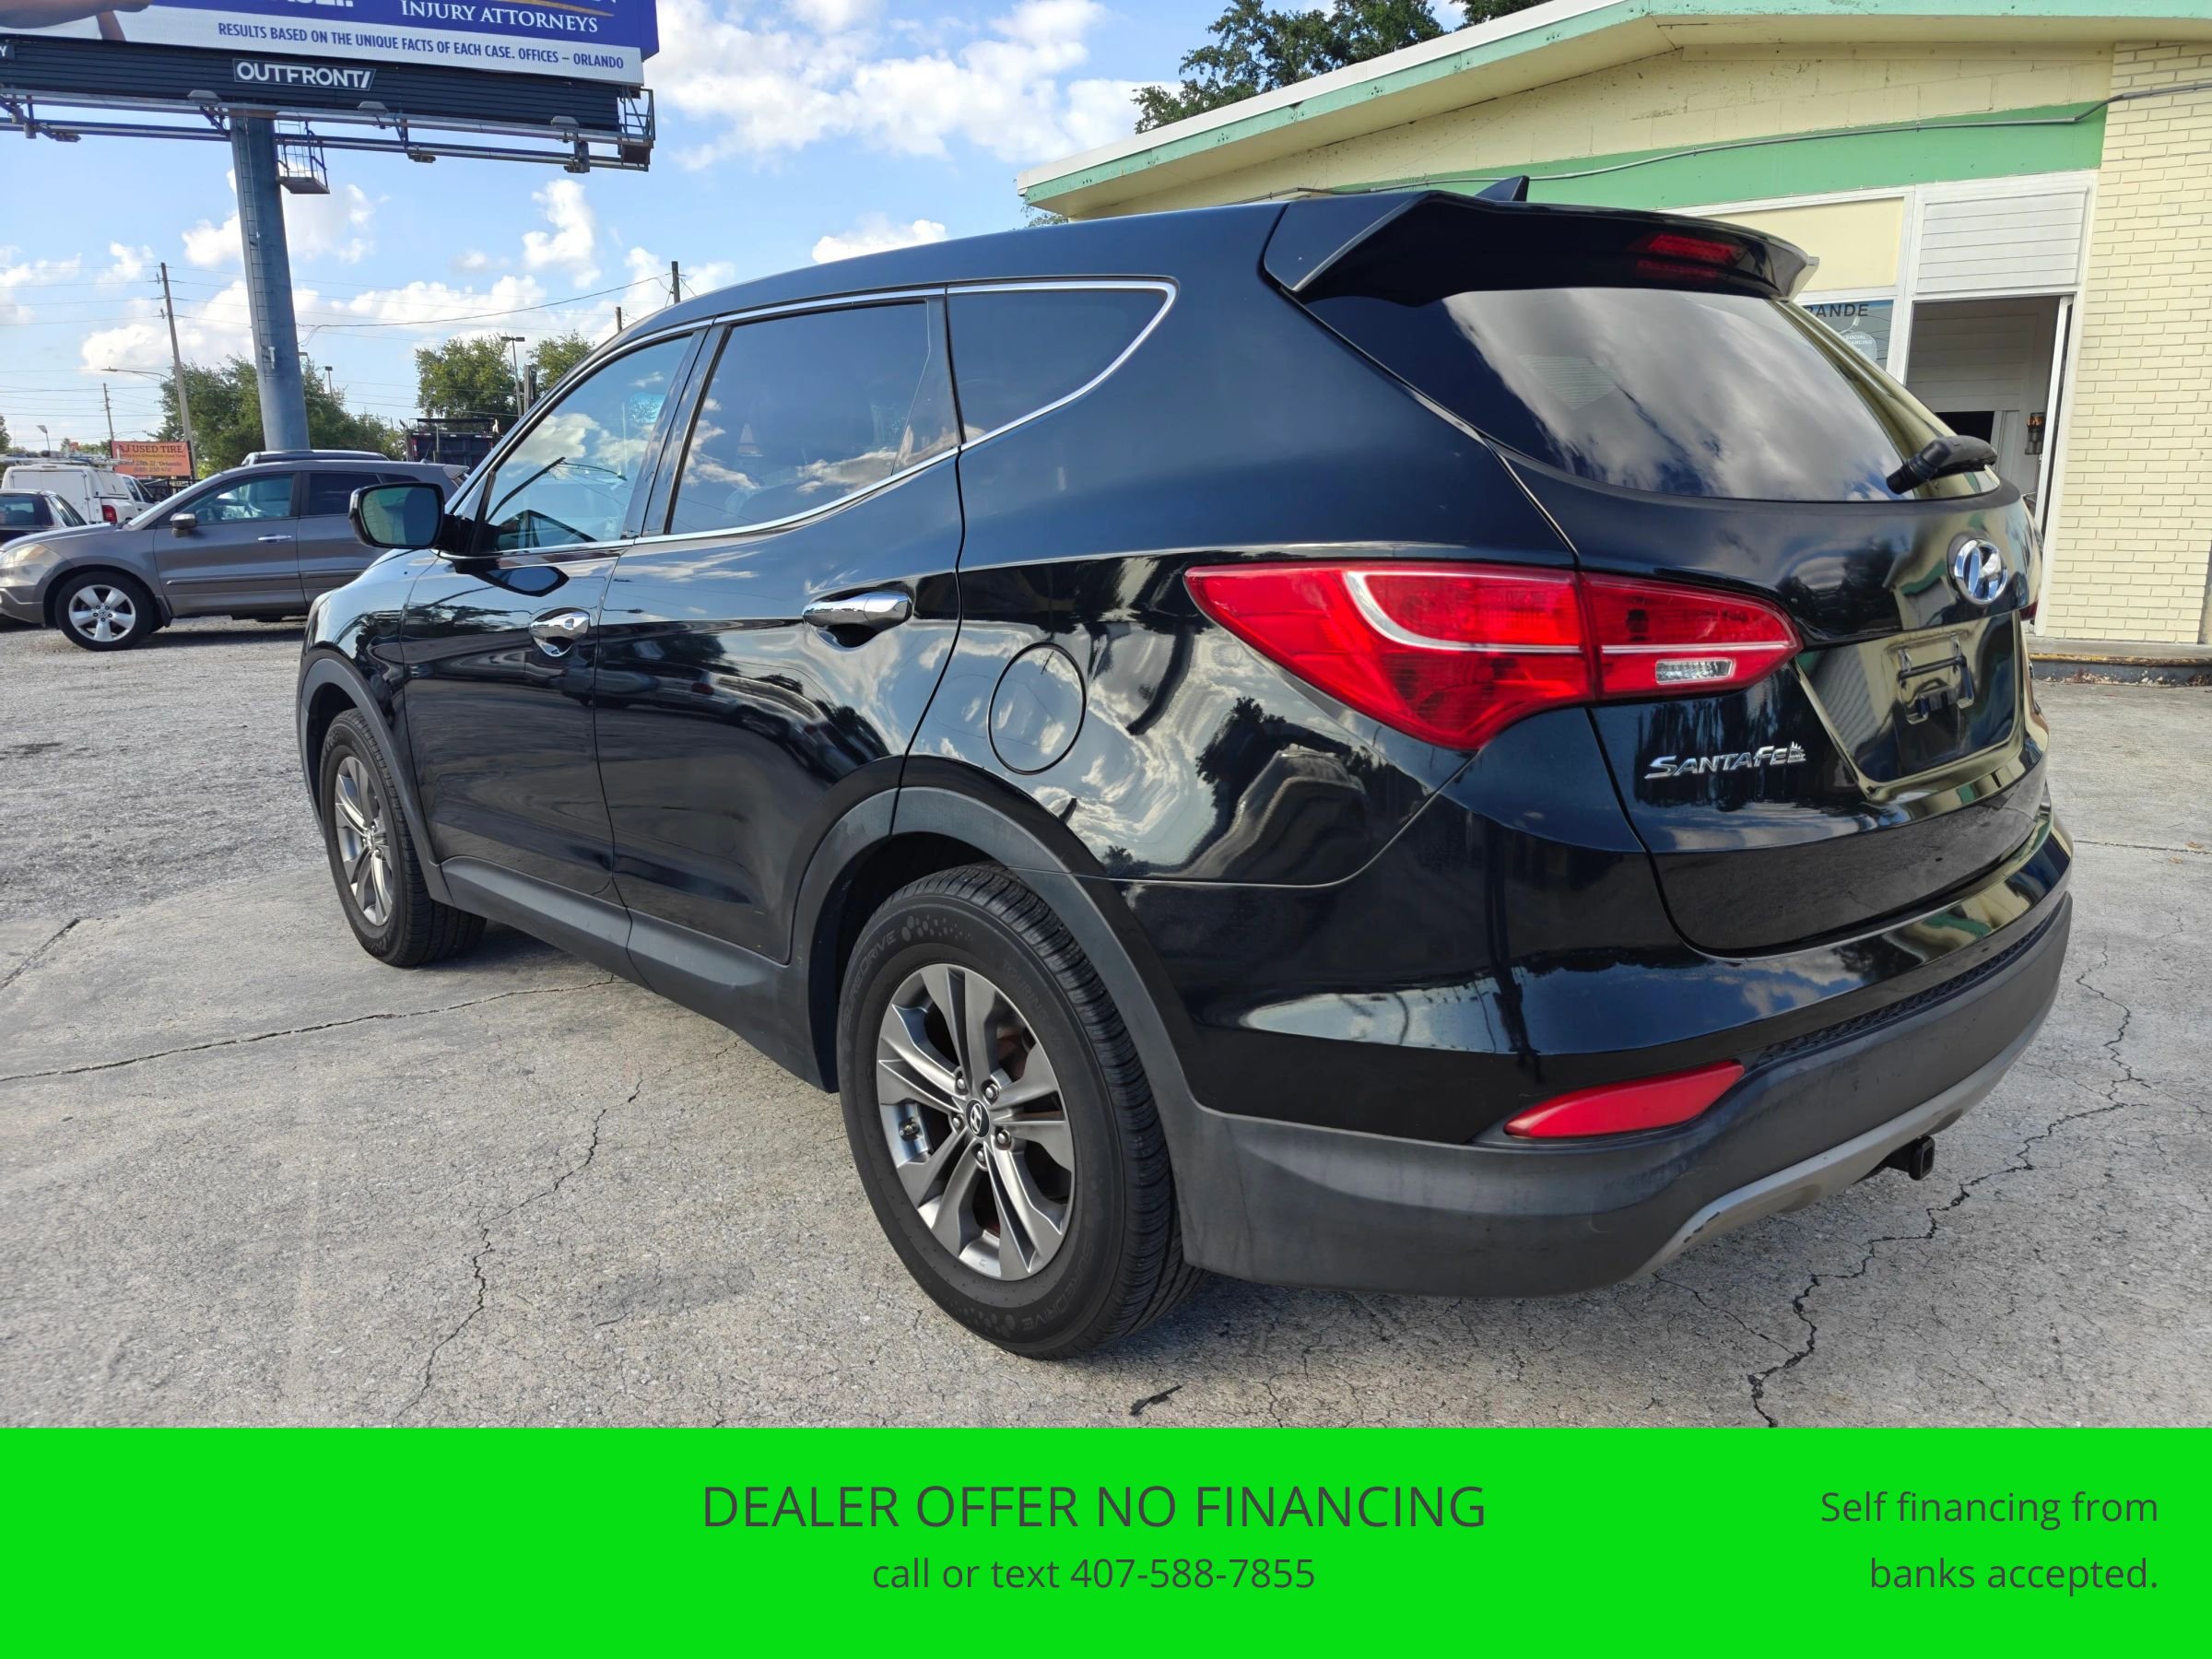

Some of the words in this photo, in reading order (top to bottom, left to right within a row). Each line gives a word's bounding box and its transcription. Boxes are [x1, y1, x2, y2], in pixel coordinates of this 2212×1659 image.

[402, 0, 477, 21] INJURY
[480, 7, 598, 33] ATTORNEYS
[218, 22, 267, 39] RESULTS
[270, 27, 308, 41] BASED
[312, 29, 328, 44] ON
[331, 31, 353, 45] THE
[356, 33, 399, 50] UNIQUE
[402, 38, 434, 53] FACTS
[437, 41, 451, 53] OF
[453, 42, 482, 56] EACH
[485, 45, 515, 59] CASE.
[518, 48, 559, 64] OFFICES
[573, 53, 624, 69] ORLANDO
[132, 445, 159, 453] USED
[159, 445, 183, 453] TIRE
